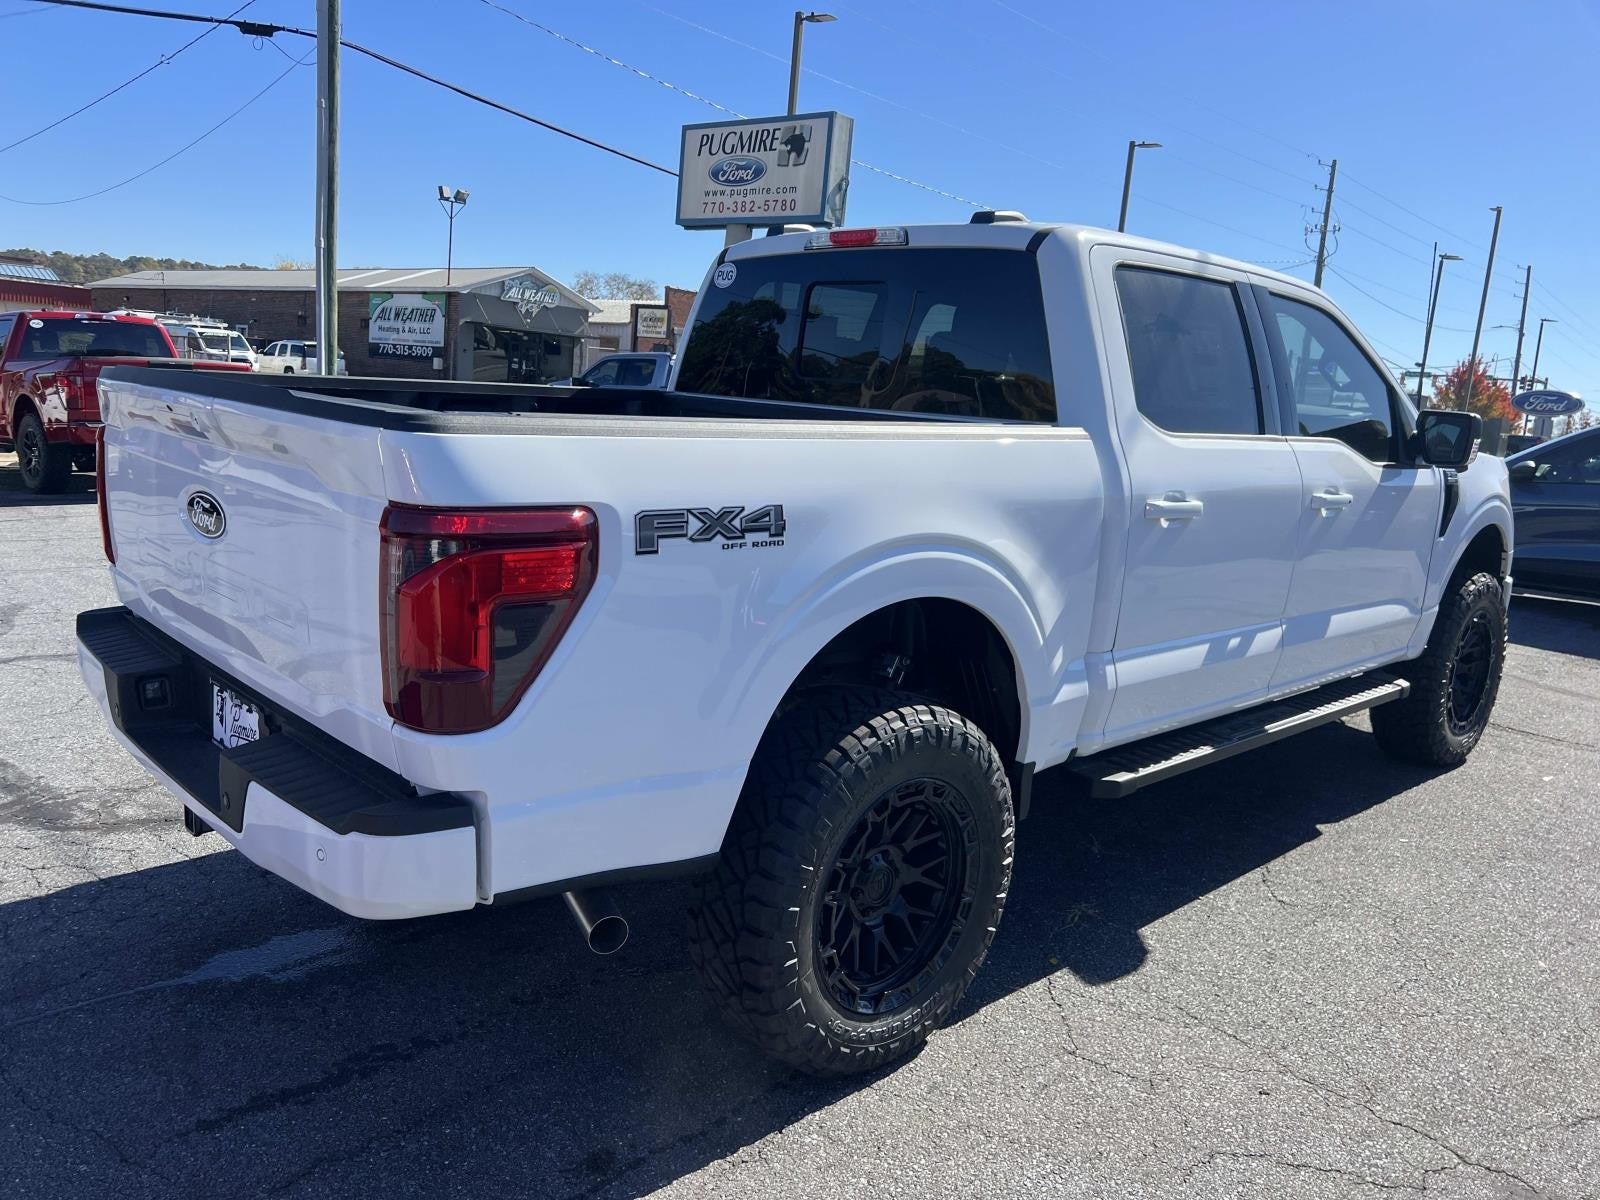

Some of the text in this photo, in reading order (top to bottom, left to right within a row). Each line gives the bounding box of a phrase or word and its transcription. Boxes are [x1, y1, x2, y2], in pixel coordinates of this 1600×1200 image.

[698, 128, 781, 156] PUGMIRE
[718, 160, 755, 181] Ford
[704, 186, 797, 199] www.pugmire.com
[702, 198, 797, 214] 770-382-5780
[717, 270, 734, 280] PUG
[506, 287, 523, 299] ALL
[374, 307, 437, 323] ALL WEATHER
[378, 325, 400, 335] Heating
[401, 326, 406, 334] &
[379, 344, 433, 357] 770-315-5909
[1524, 395, 1568, 411] Ford
[192, 498, 217, 532] Ford
[635, 504, 786, 555] FX4
[722, 540, 785, 550] OFF ROAD
